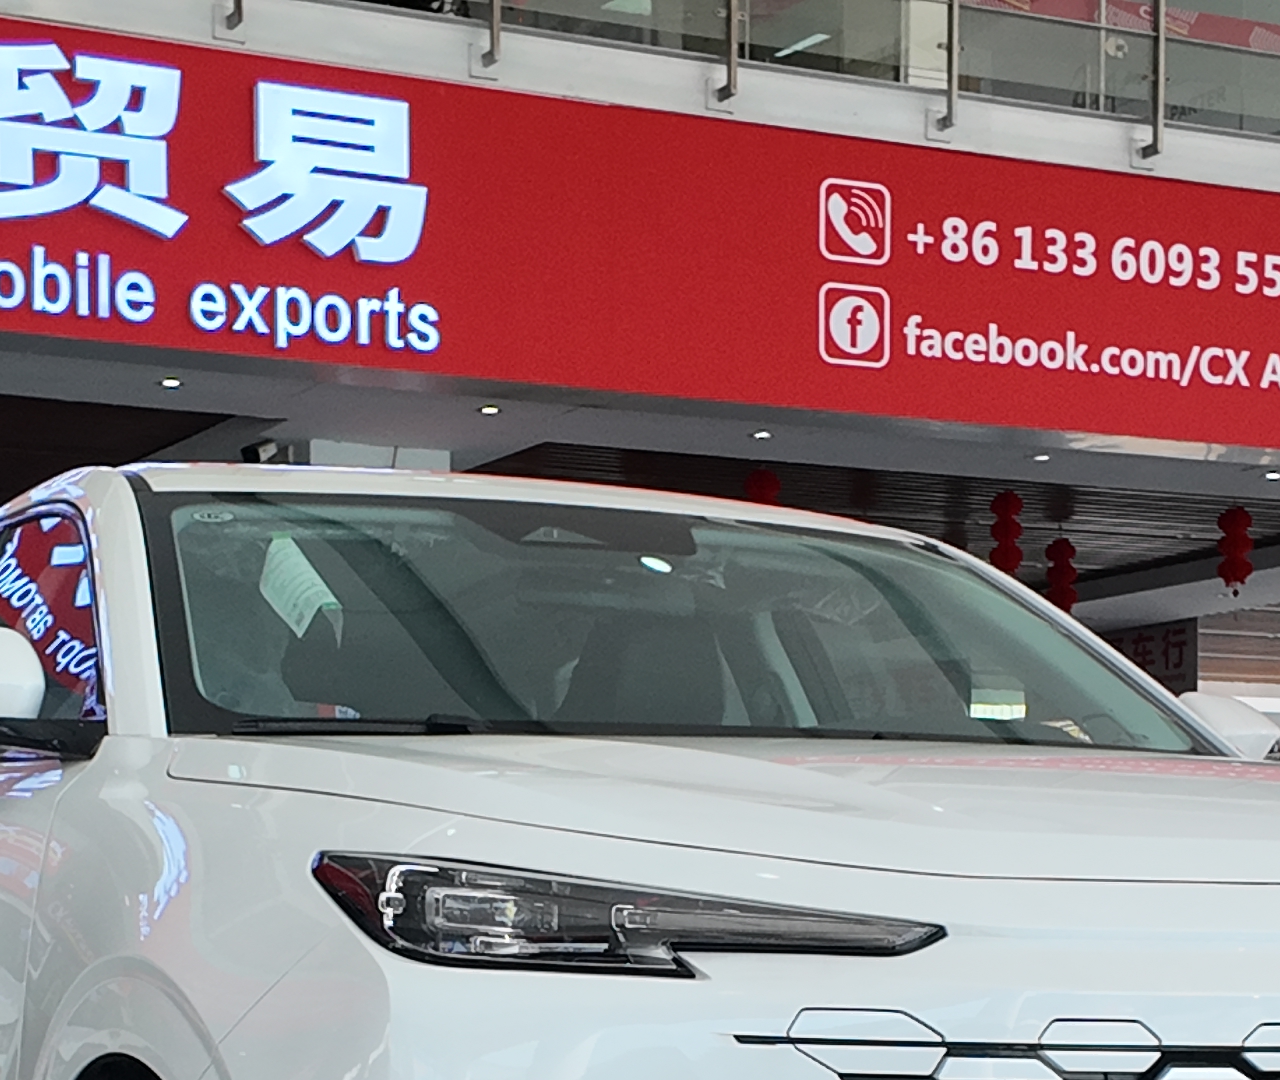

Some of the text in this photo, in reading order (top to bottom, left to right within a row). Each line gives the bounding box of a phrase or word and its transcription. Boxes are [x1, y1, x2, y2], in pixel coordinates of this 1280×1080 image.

[906, 216, 999, 266] +86
[1013, 225, 1097, 277] 133
[1111, 236, 1221, 290] 6093
[189, 281, 441, 352] exports
[903, 314, 1251, 387] facebook.com/CX
